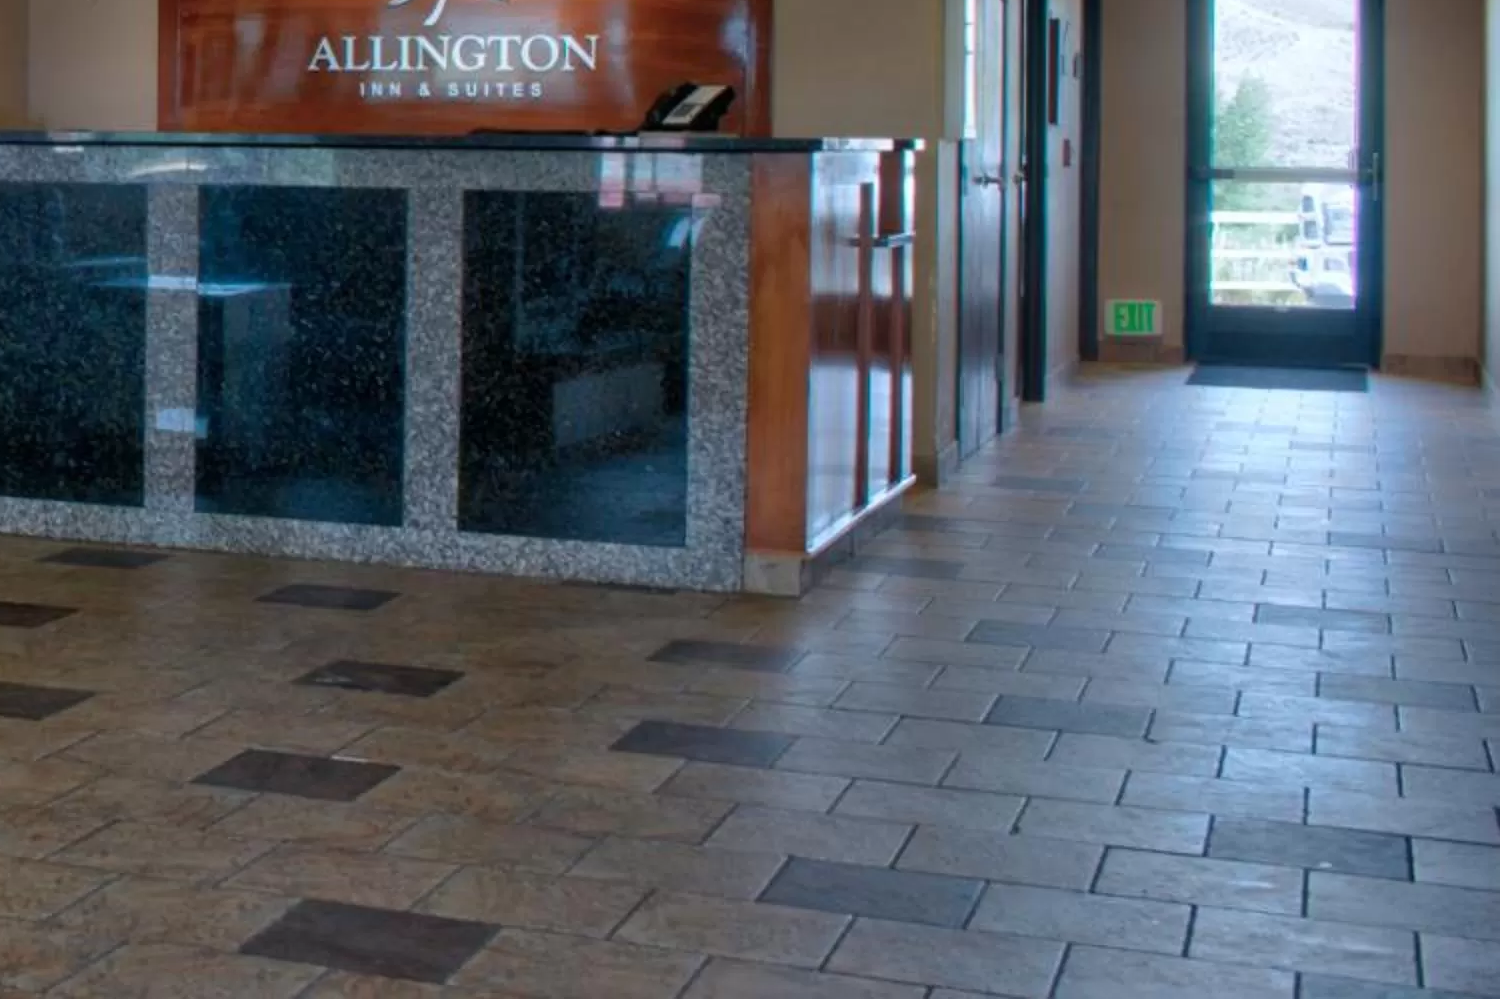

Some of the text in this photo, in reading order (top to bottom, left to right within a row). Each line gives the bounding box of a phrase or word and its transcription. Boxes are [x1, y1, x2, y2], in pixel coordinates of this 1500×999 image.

[307, 34, 599, 72] ALLINGTON
[359, 81, 543, 98] INN & SUITES
[1114, 302, 1157, 333] EXIT
